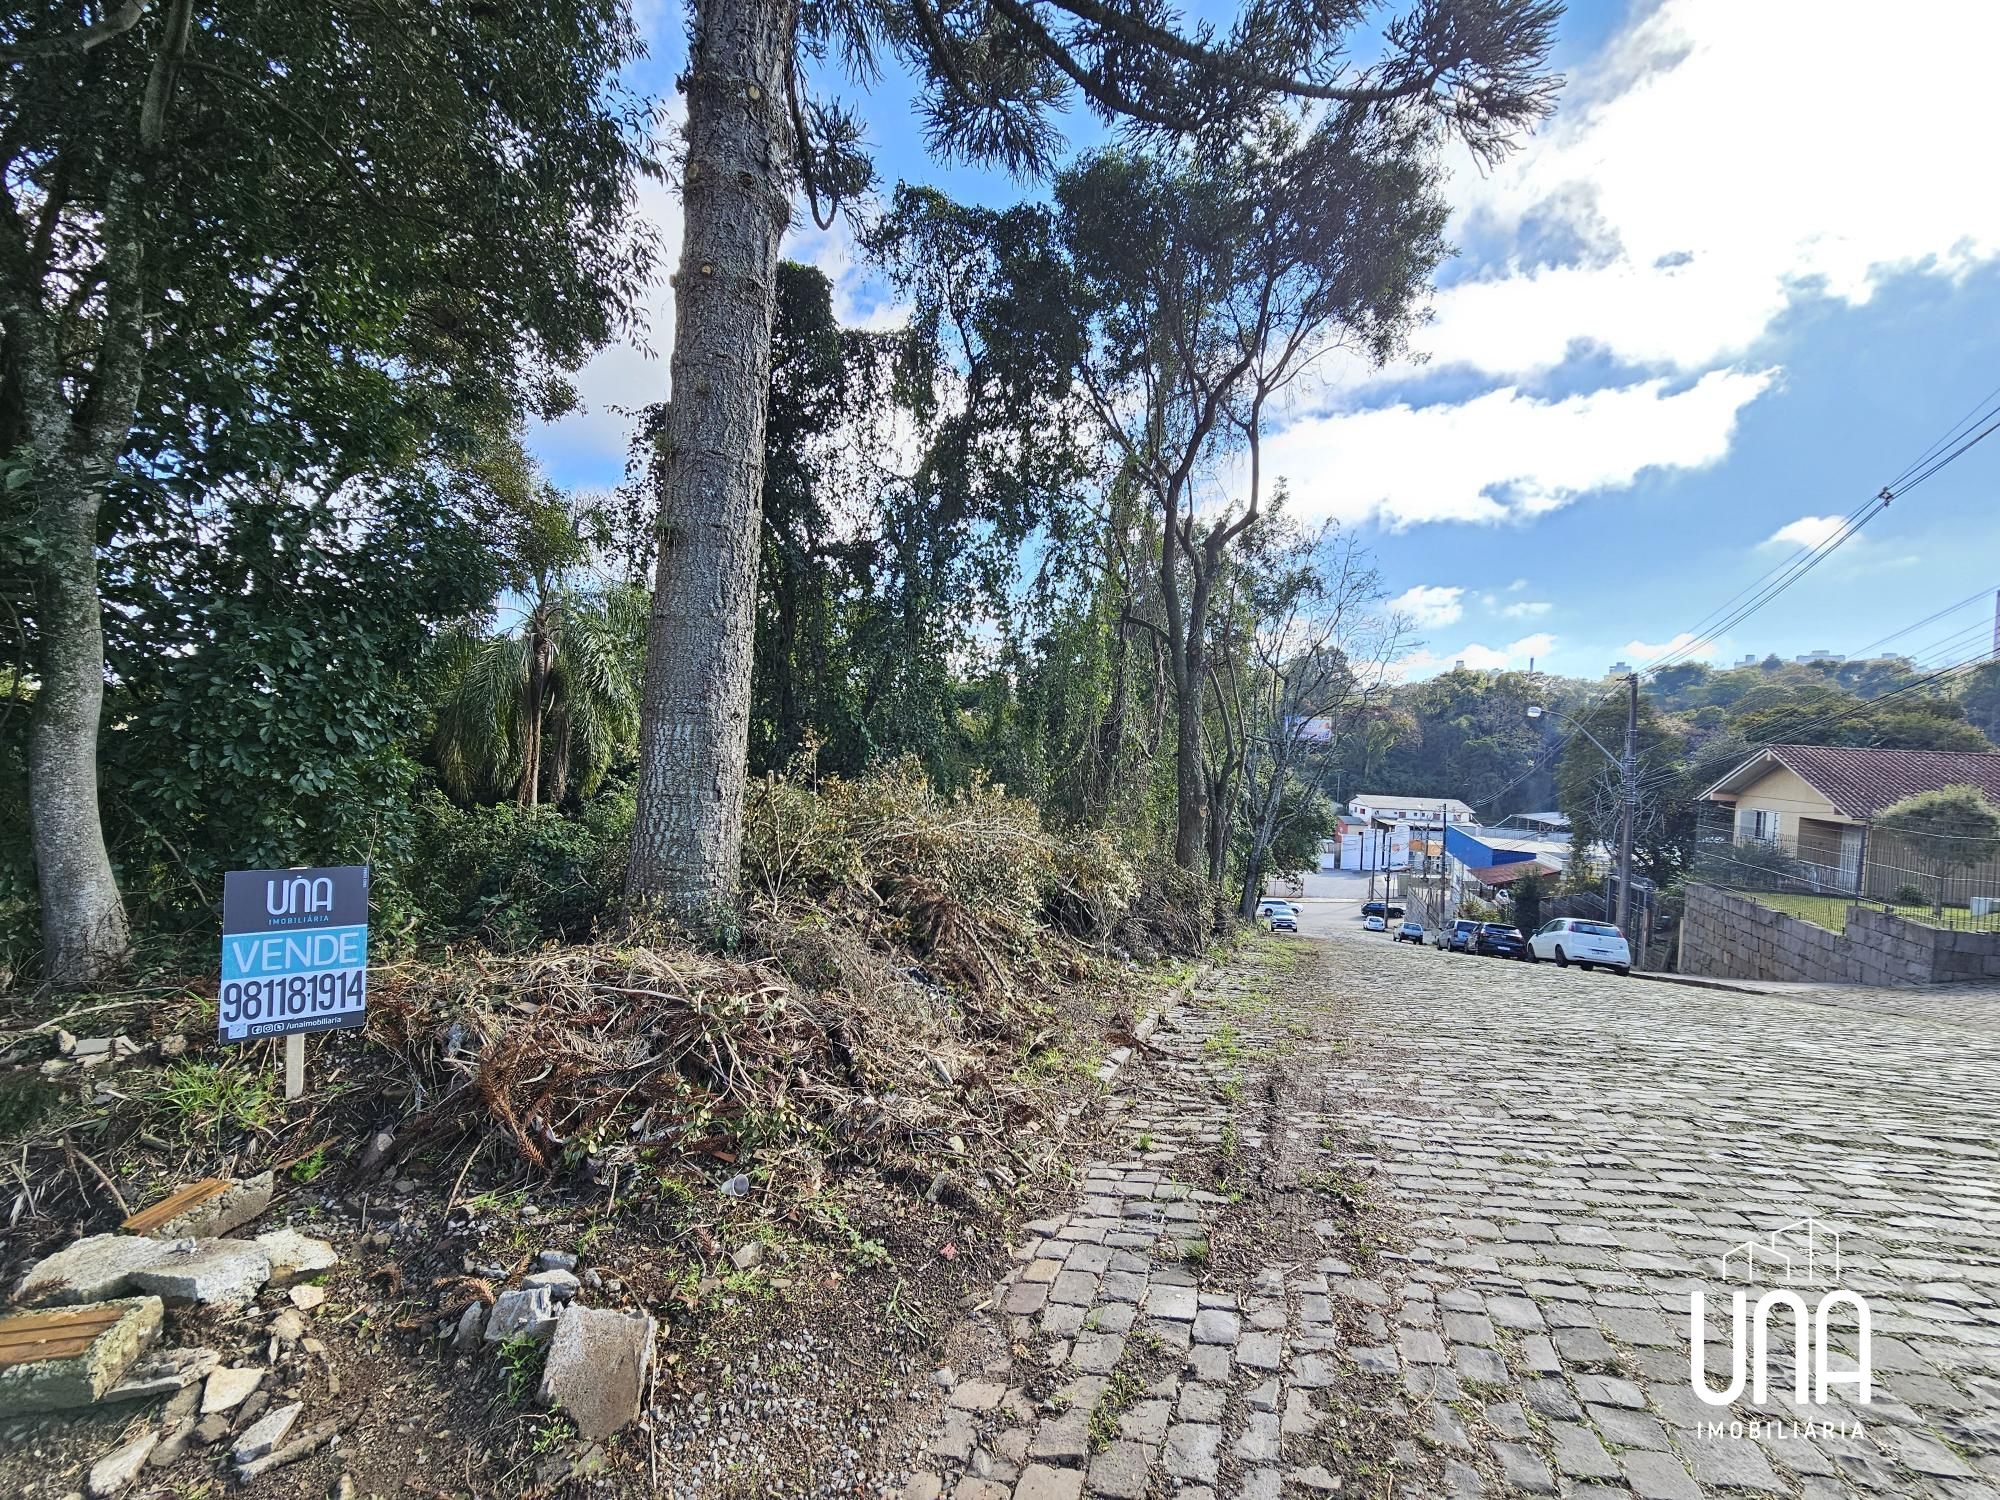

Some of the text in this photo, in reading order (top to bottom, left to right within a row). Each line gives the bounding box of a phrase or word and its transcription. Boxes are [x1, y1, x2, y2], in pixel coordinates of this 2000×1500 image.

[266, 877, 333, 915] UNA
[268, 915, 329, 926] IMOBILIÁRIA
[232, 932, 359, 974] VENDE
[223, 970, 364, 1022] 981181914
